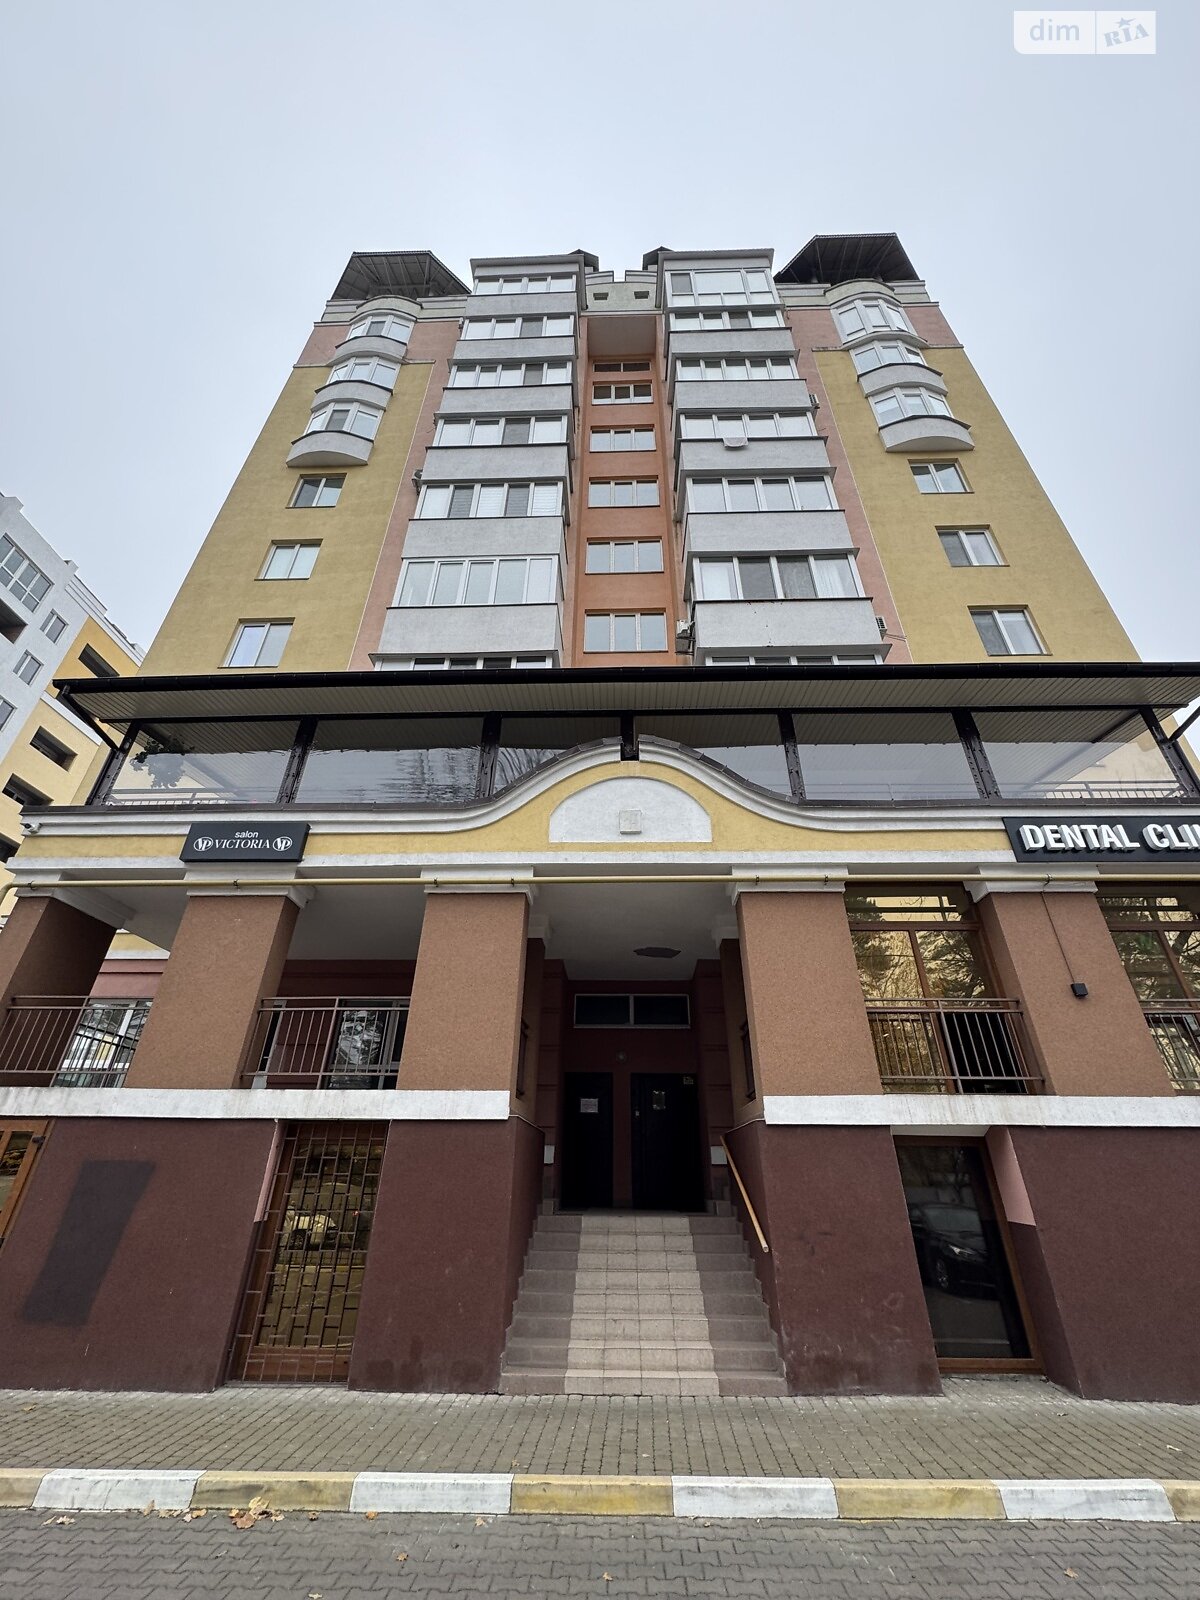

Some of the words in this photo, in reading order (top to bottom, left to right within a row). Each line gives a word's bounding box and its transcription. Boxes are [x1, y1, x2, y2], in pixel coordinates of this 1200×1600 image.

[234, 830, 259, 839] salon
[1019, 824, 1141, 850] DENTAL
[215, 839, 270, 849] VICTORIA
